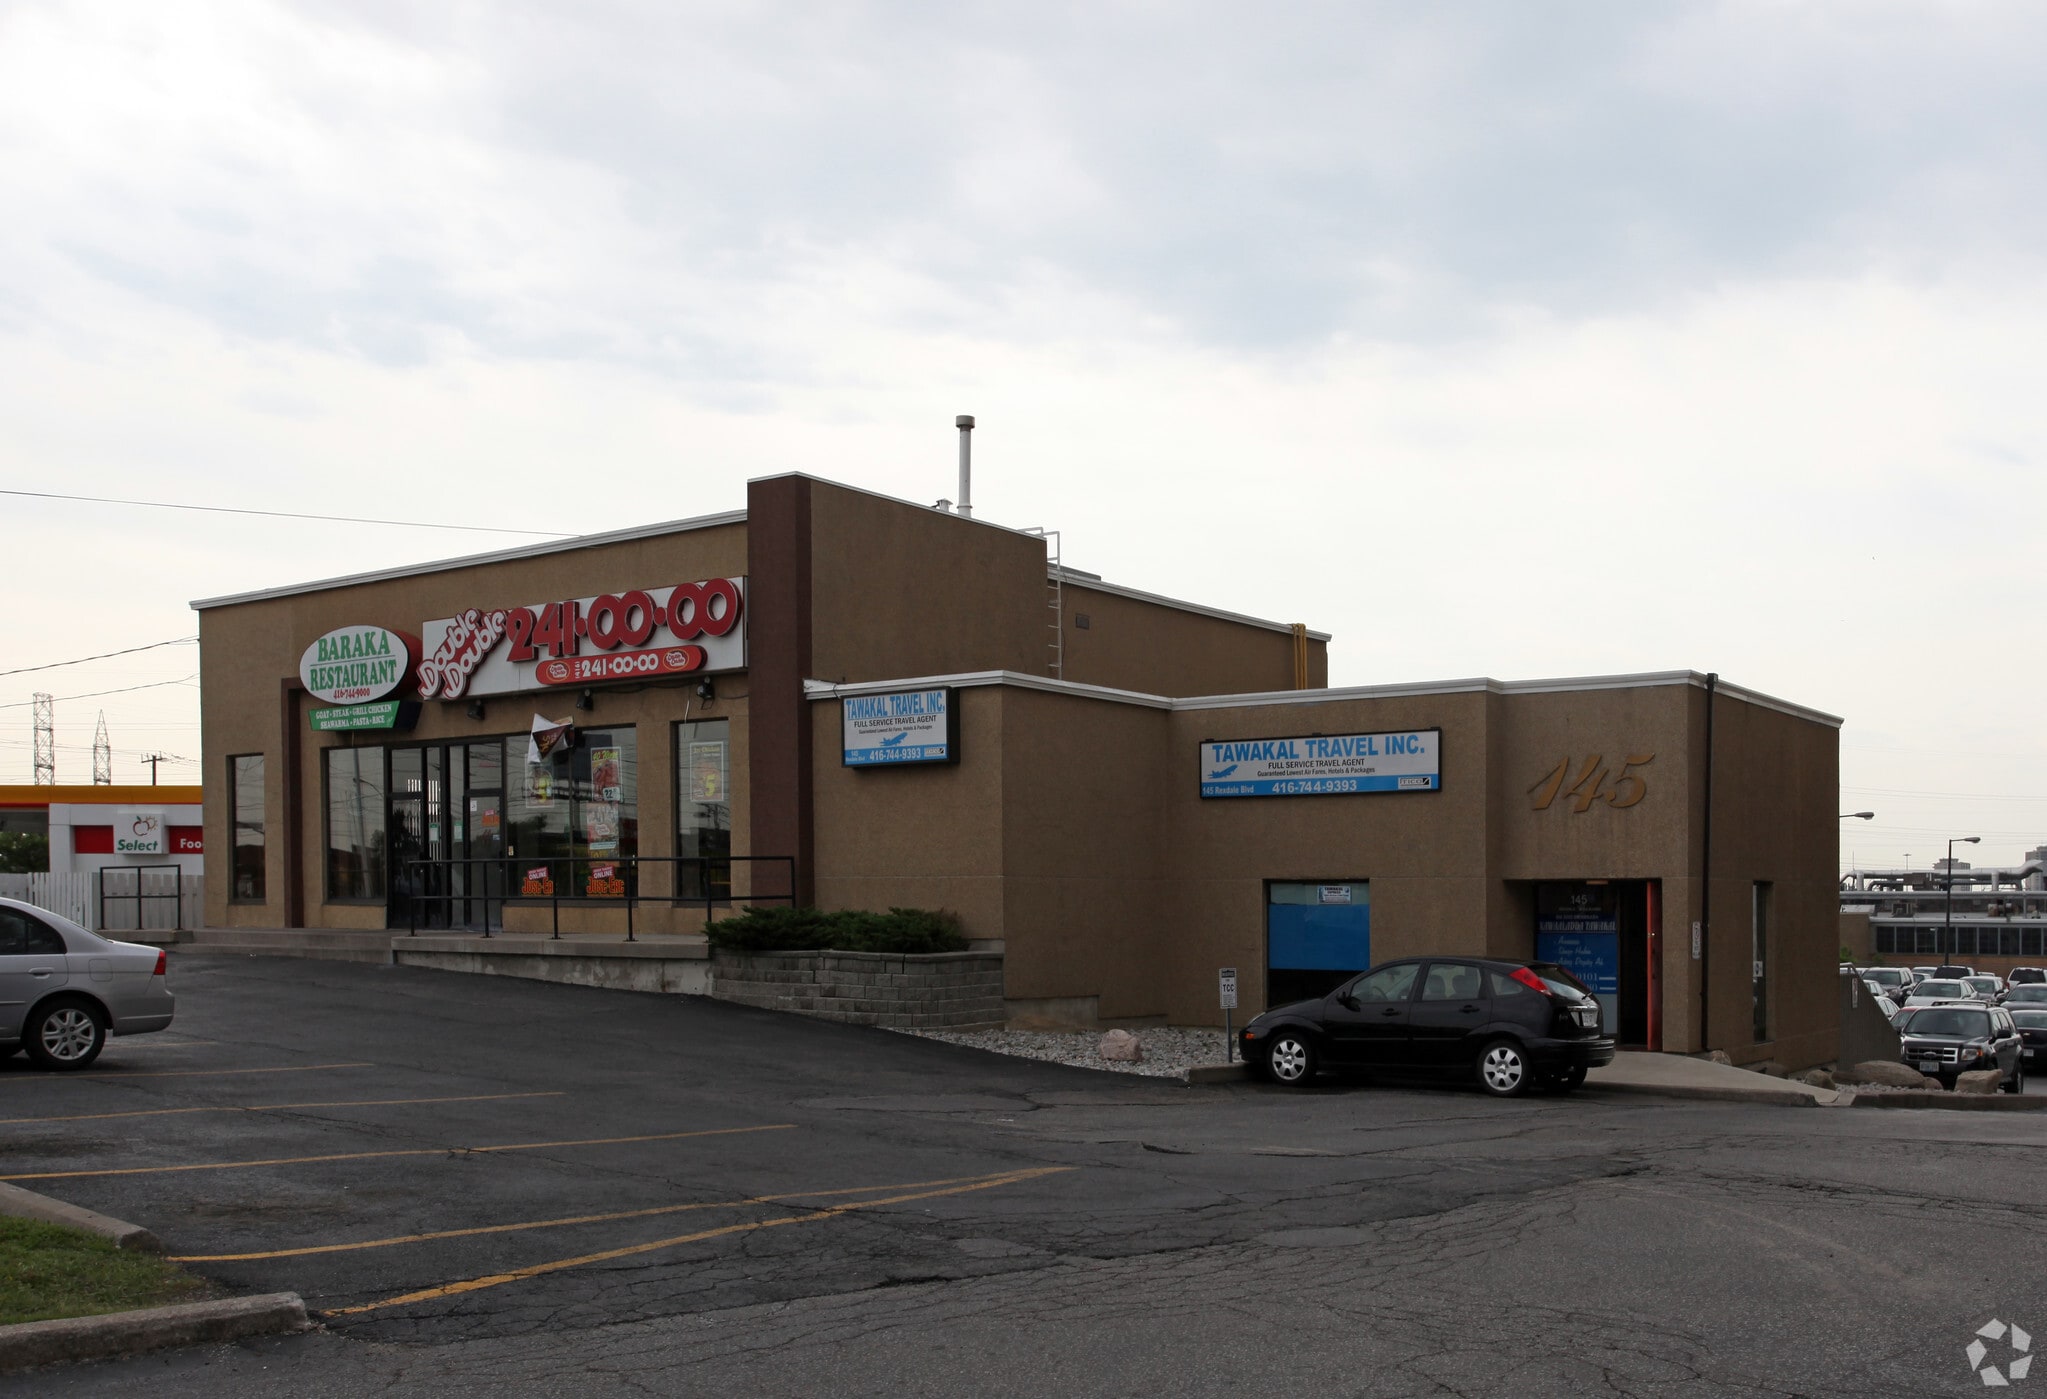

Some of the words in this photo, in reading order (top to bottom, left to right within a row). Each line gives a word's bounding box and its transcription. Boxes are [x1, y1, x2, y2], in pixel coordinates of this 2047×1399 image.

[318, 630, 391, 662] BARAKA
[418, 608, 479, 697] Double
[443, 610, 506, 699] Double
[310, 659, 397, 691] RESTAURANT
[333, 687, 371, 699] 416-744-9000
[316, 710, 330, 720] GOAT
[332, 708, 350, 717] STEAK
[352, 706, 368, 716] GRILL
[368, 704, 392, 714] CHICKEN
[846, 696, 888, 719] TAWAKAL
[890, 694, 924, 716] TRAVEL
[926, 692, 945, 712] INC.
[320, 720, 350, 729] SHAWARMA
[352, 717, 370, 726] PASTA
[854, 720, 868, 728] FULL
[869, 717, 893, 727] SERVICE
[894, 716, 916, 725] TRAVEL
[917, 714, 936, 723] AGENT
[870, 747, 921, 761] 416-744-9393
[1212, 741, 1300, 763] TAWAKAL
[1305, 736, 1379, 758] TRAVEL
[1385, 734, 1424, 754] INC.
[1286, 760, 1314, 768] SERVICE
[1316, 760, 1340, 768] TRAVEL
[1342, 758, 1365, 766] AGENT
[1350, 766, 1375, 774] Packages
[1202, 786, 1214, 795] 145
[1215, 786, 1240, 795] Rexdale
[1240, 784, 1254, 794] Blvd
[1272, 780, 1358, 794] 416-744-9393
[1526, 752, 1656, 814] 145
[117, 838, 158, 851] Select
[180, 838, 203, 849] Foo
[529, 870, 548, 880] ONLINE
[593, 869, 614, 879] ONLINE
[1570, 894, 1588, 905] 145
[1222, 984, 1235, 992] TCC
